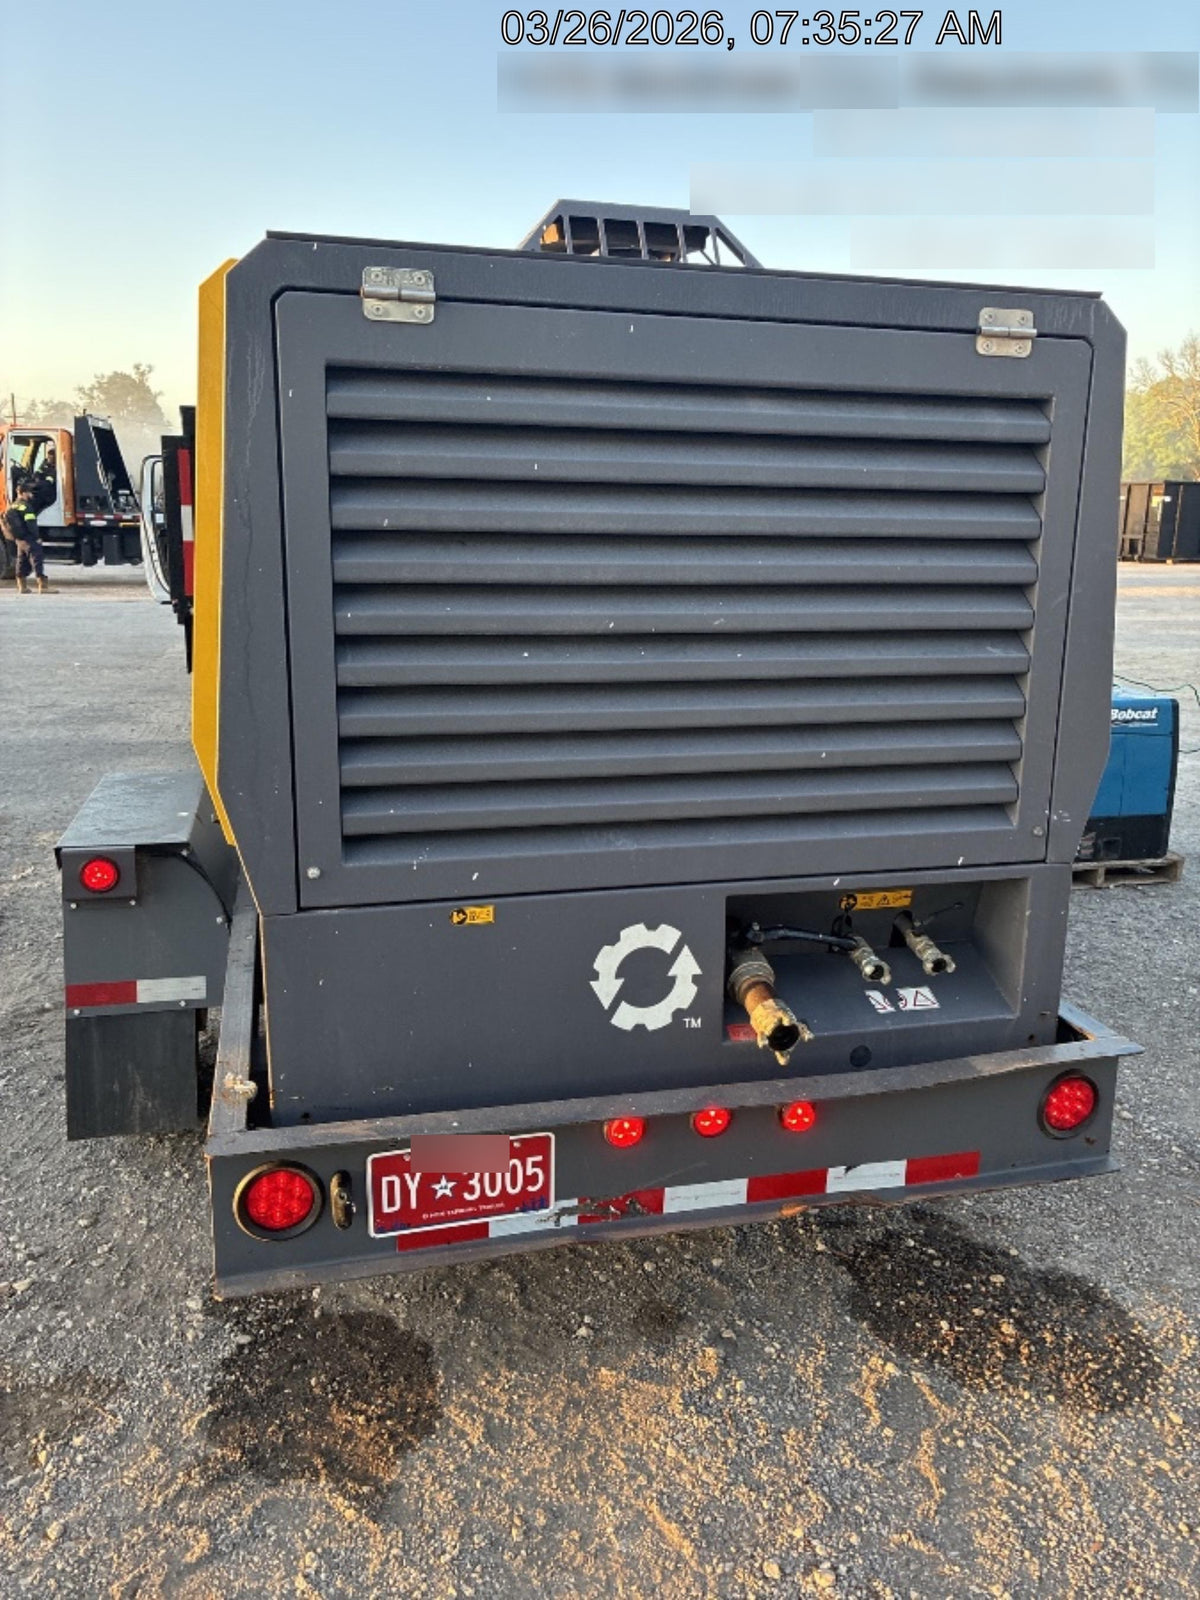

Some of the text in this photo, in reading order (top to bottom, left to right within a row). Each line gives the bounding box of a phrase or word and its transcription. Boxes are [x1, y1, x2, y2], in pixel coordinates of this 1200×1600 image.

[1110, 707, 1158, 720] Bobcat
[682, 1017, 702, 1029] TM
[381, 1172, 422, 1214] DY
